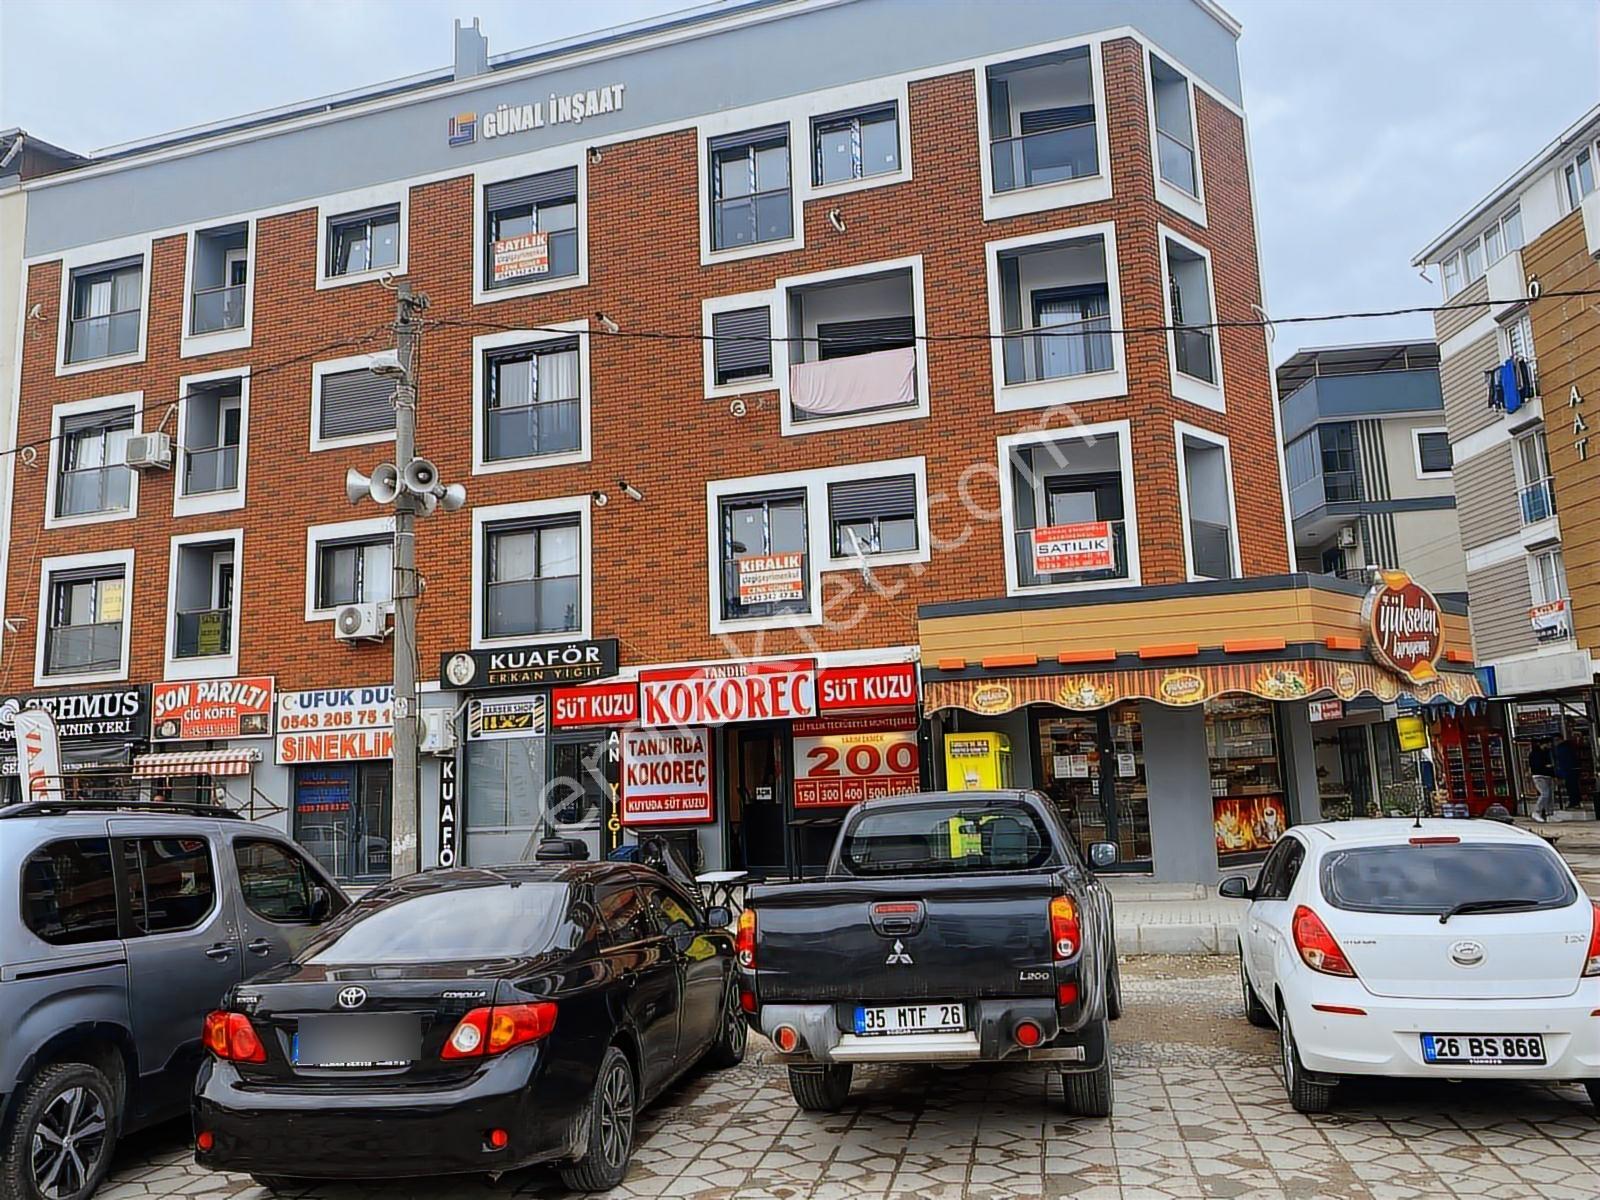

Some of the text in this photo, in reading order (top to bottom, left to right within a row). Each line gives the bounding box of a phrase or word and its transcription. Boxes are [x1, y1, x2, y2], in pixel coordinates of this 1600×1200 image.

[482, 83, 625, 139] GÜNAL İNŞAAT
[1039, 539, 1105, 554] SATILIK
[491, 644, 600, 669] KUAFÖR
[489, 671, 544, 684] ERKAN
[704, 665, 748, 679] TANDIR
[824, 674, 912, 702] SÜT KUZU
[155, 681, 268, 717] SON PARILTI
[299, 690, 354, 709] UFUK
[556, 693, 634, 720] SÜT KUZU
[645, 674, 811, 724] KOKOREÇ
[98, 717, 131, 734] YERİ
[281, 713, 319, 729] 0543
[323, 711, 353, 727] 205
[358, 709, 377, 725] 75
[629, 736, 704, 756] TANDIRDA
[807, 741, 919, 778] 200
[627, 759, 706, 787] KOKOREÇ
[664, 797, 680, 810] SÜT
[798, 790, 815, 802] 150
[821, 789, 839, 800] 300
[845, 788, 862, 799] 400
[868, 787, 887, 799] 500
[1020, 971, 1050, 981] L200
[866, 1006, 961, 1028] 35 MTF 26
[1435, 1037, 1541, 1058] 26 BS 868
